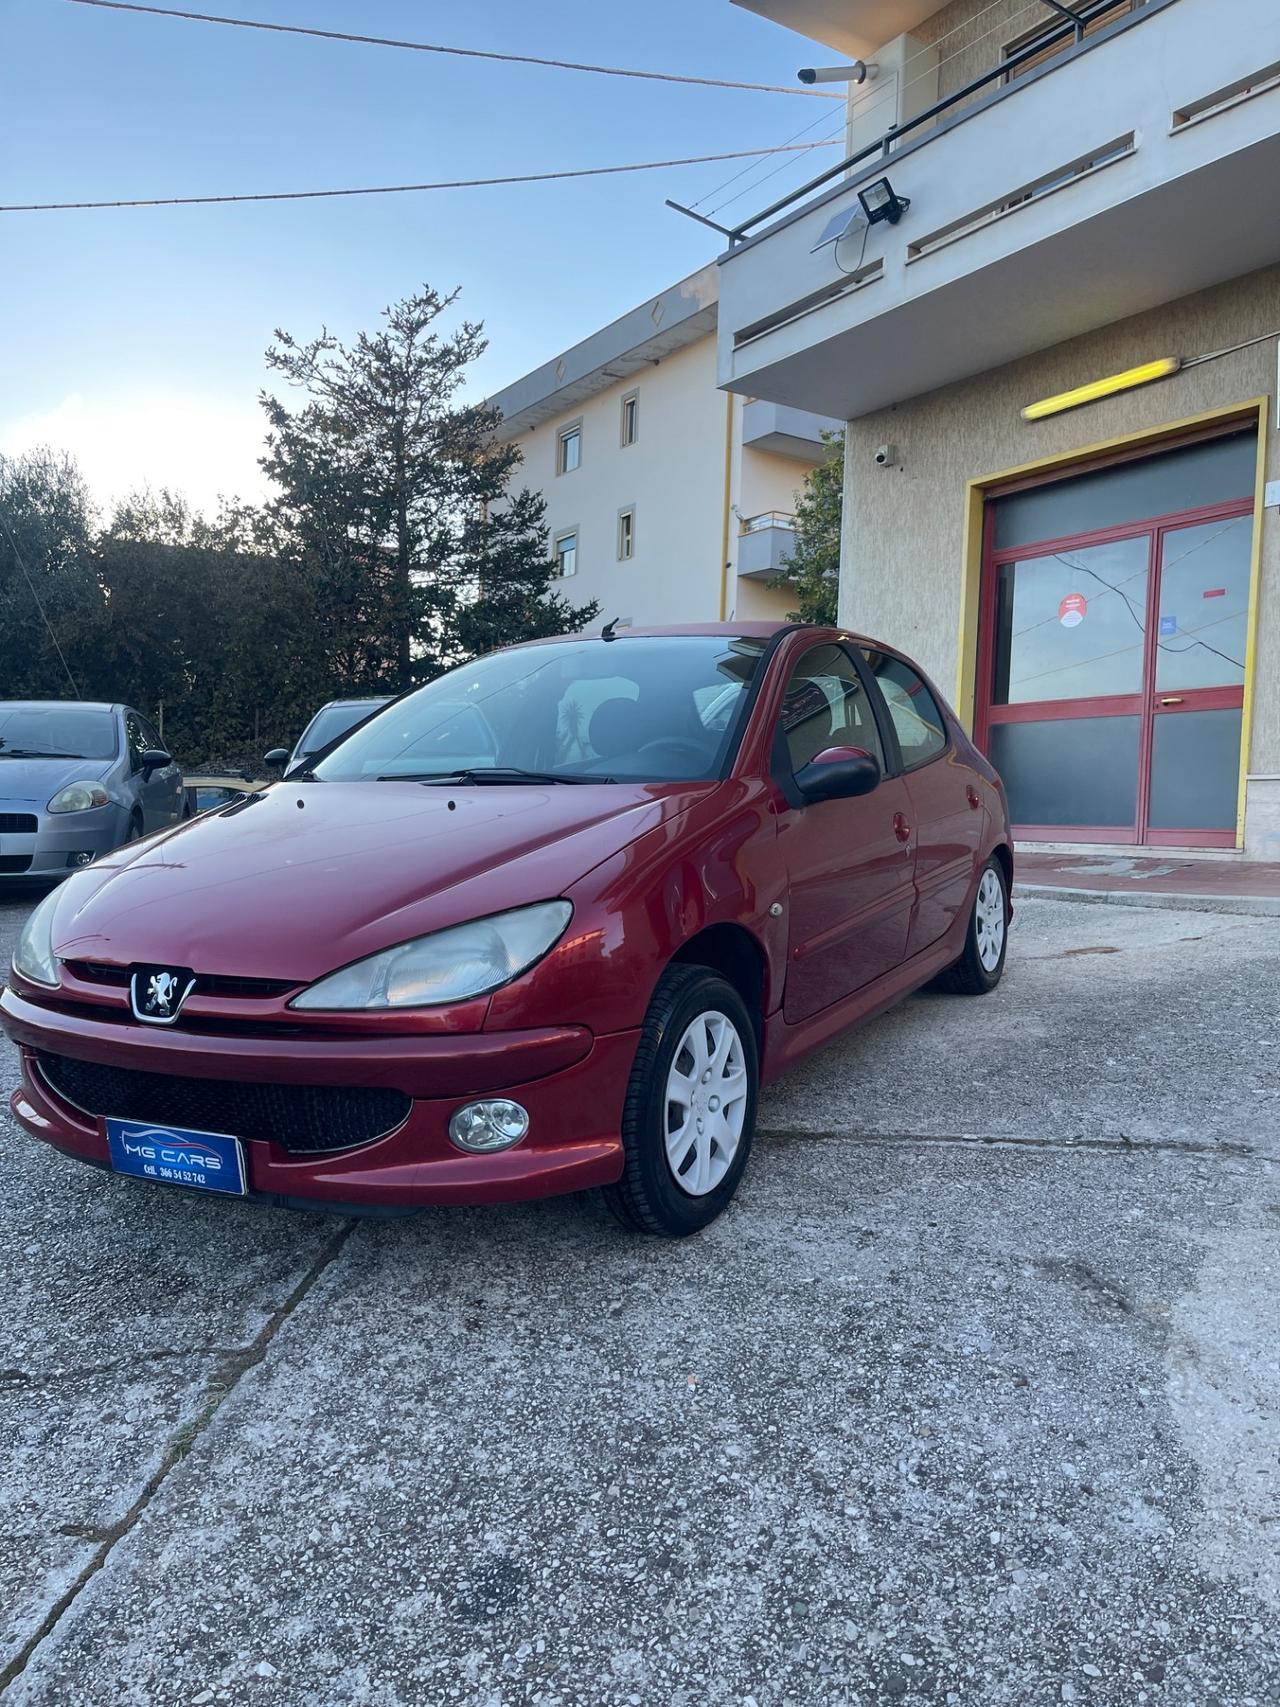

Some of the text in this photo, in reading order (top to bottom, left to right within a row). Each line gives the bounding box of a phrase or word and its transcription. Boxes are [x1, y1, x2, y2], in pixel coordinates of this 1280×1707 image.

[126, 1144, 222, 1169] MG CARS
[173, 1169, 182, 1179] 54
[183, 1171, 192, 1181] 52
[193, 1173, 206, 1184] 742
